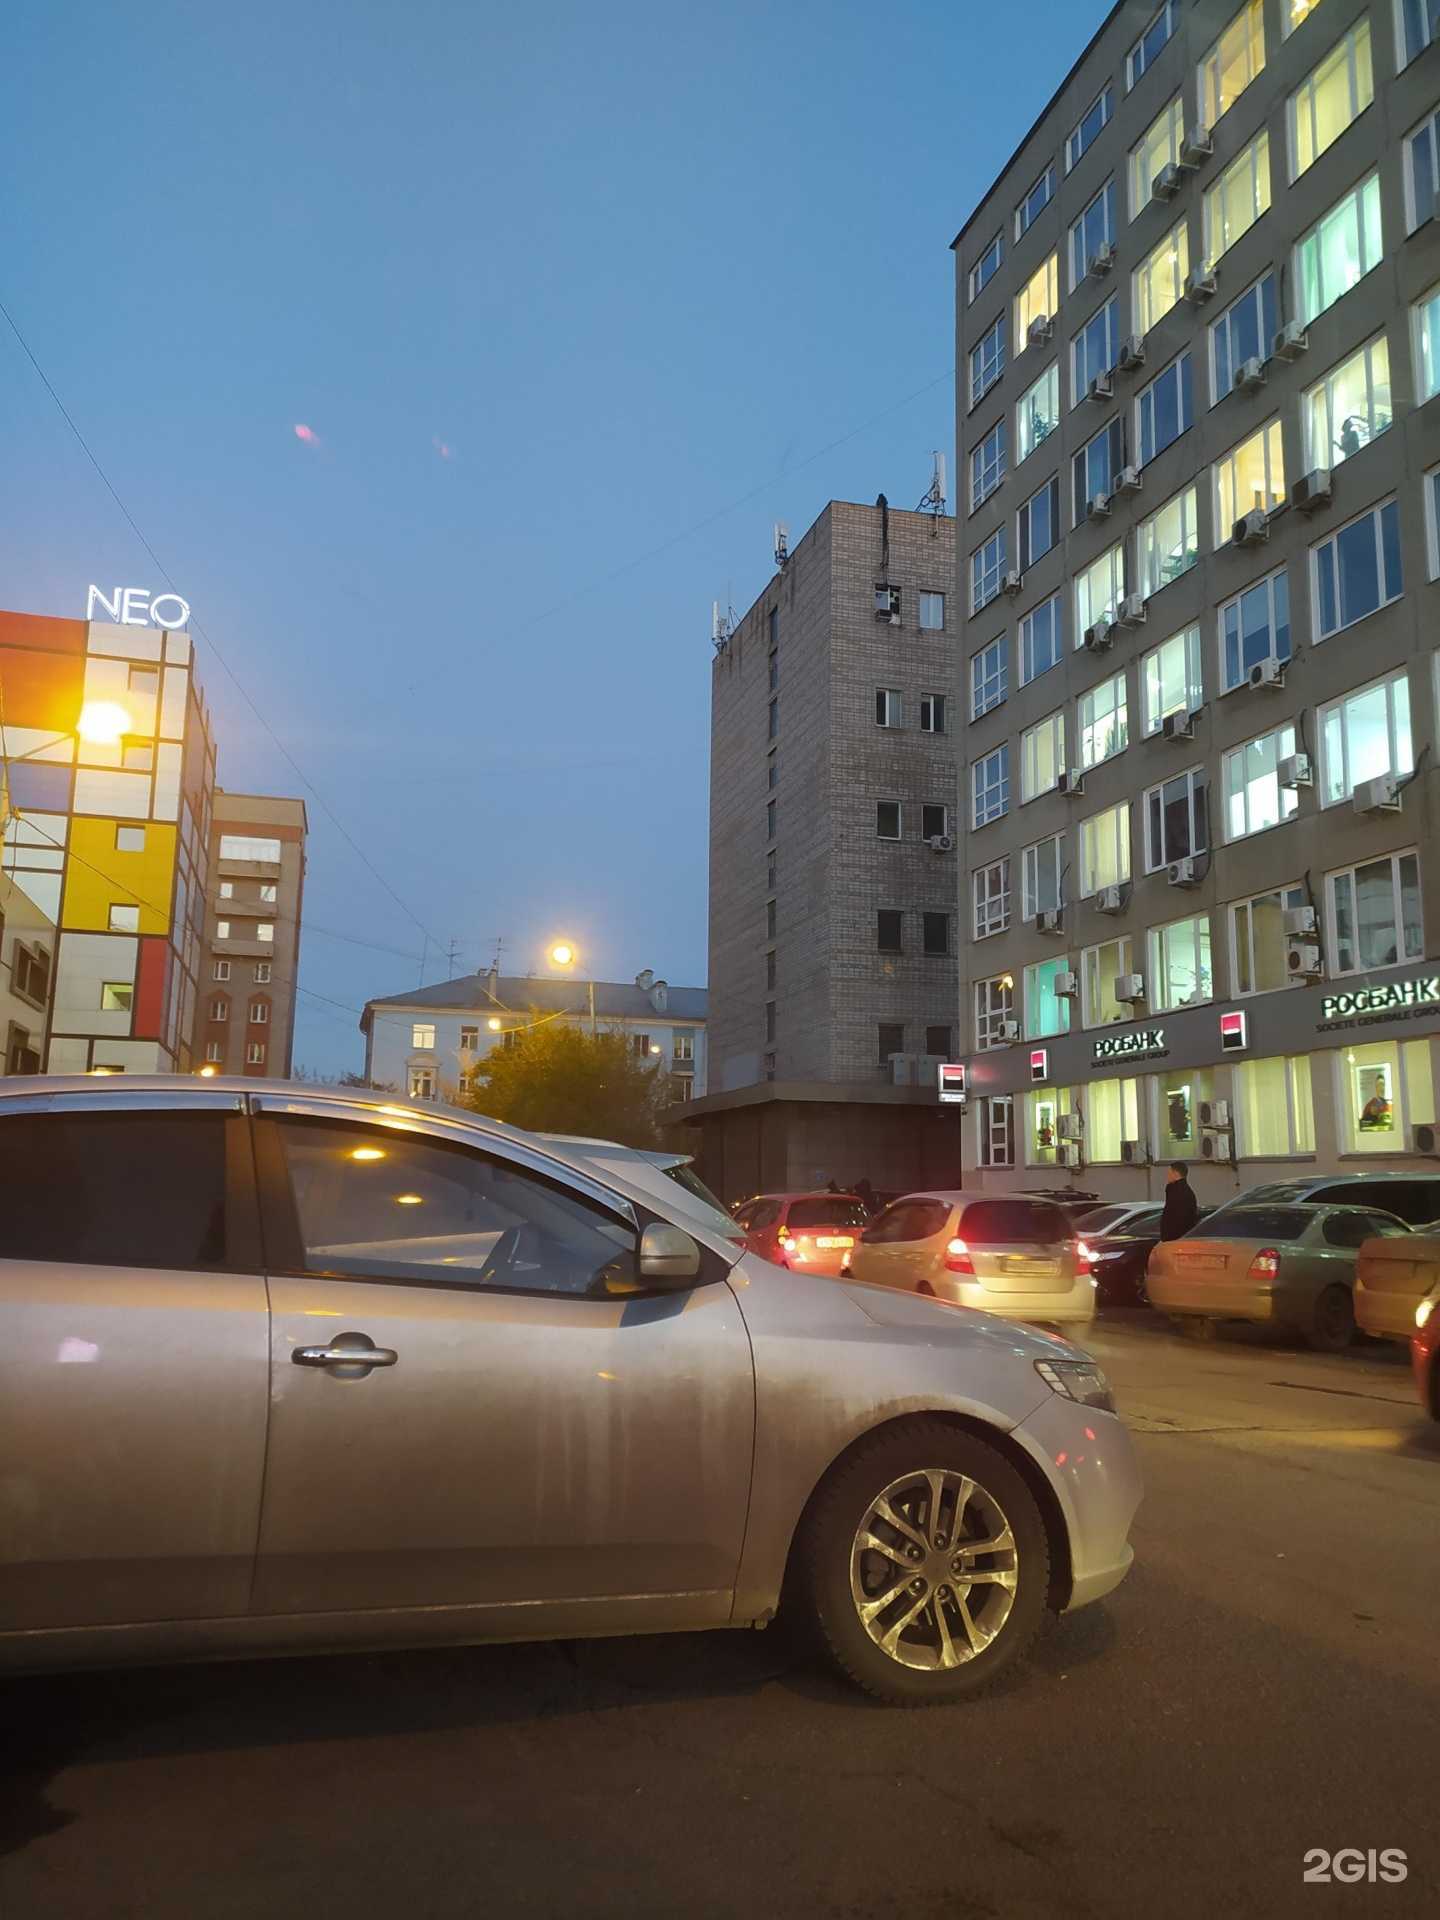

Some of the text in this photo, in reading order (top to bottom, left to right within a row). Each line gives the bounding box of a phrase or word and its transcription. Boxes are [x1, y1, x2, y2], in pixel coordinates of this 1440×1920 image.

[86, 584, 190, 629] NEO
[1320, 977, 1440, 1018] РОСБАНК
[1094, 1029, 1164, 1058] РОСБАНК
